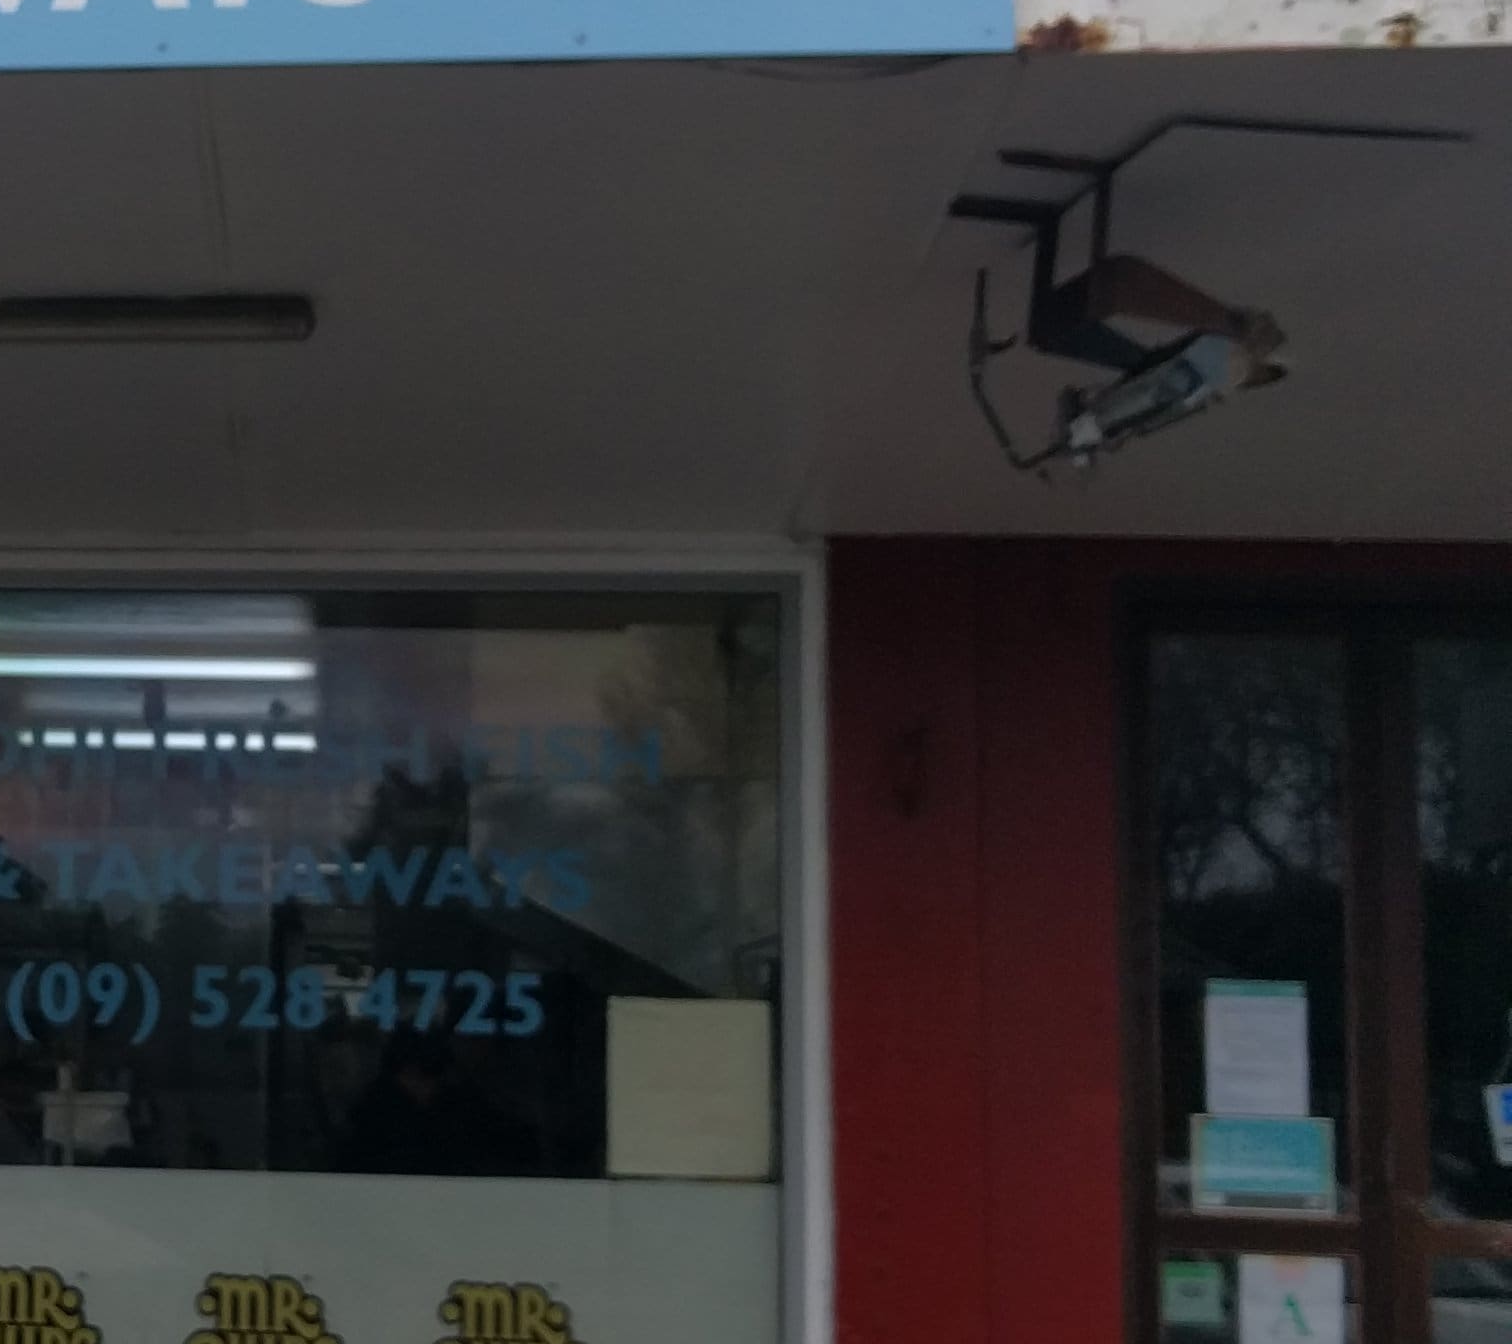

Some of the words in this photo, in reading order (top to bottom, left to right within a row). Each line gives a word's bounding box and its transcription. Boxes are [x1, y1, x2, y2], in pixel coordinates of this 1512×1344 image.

[52, 843, 593, 911] TAKEAWAYS
[5, 959, 163, 1043] (09)
[190, 965, 326, 1030] 528
[358, 968, 545, 1037] 4725
